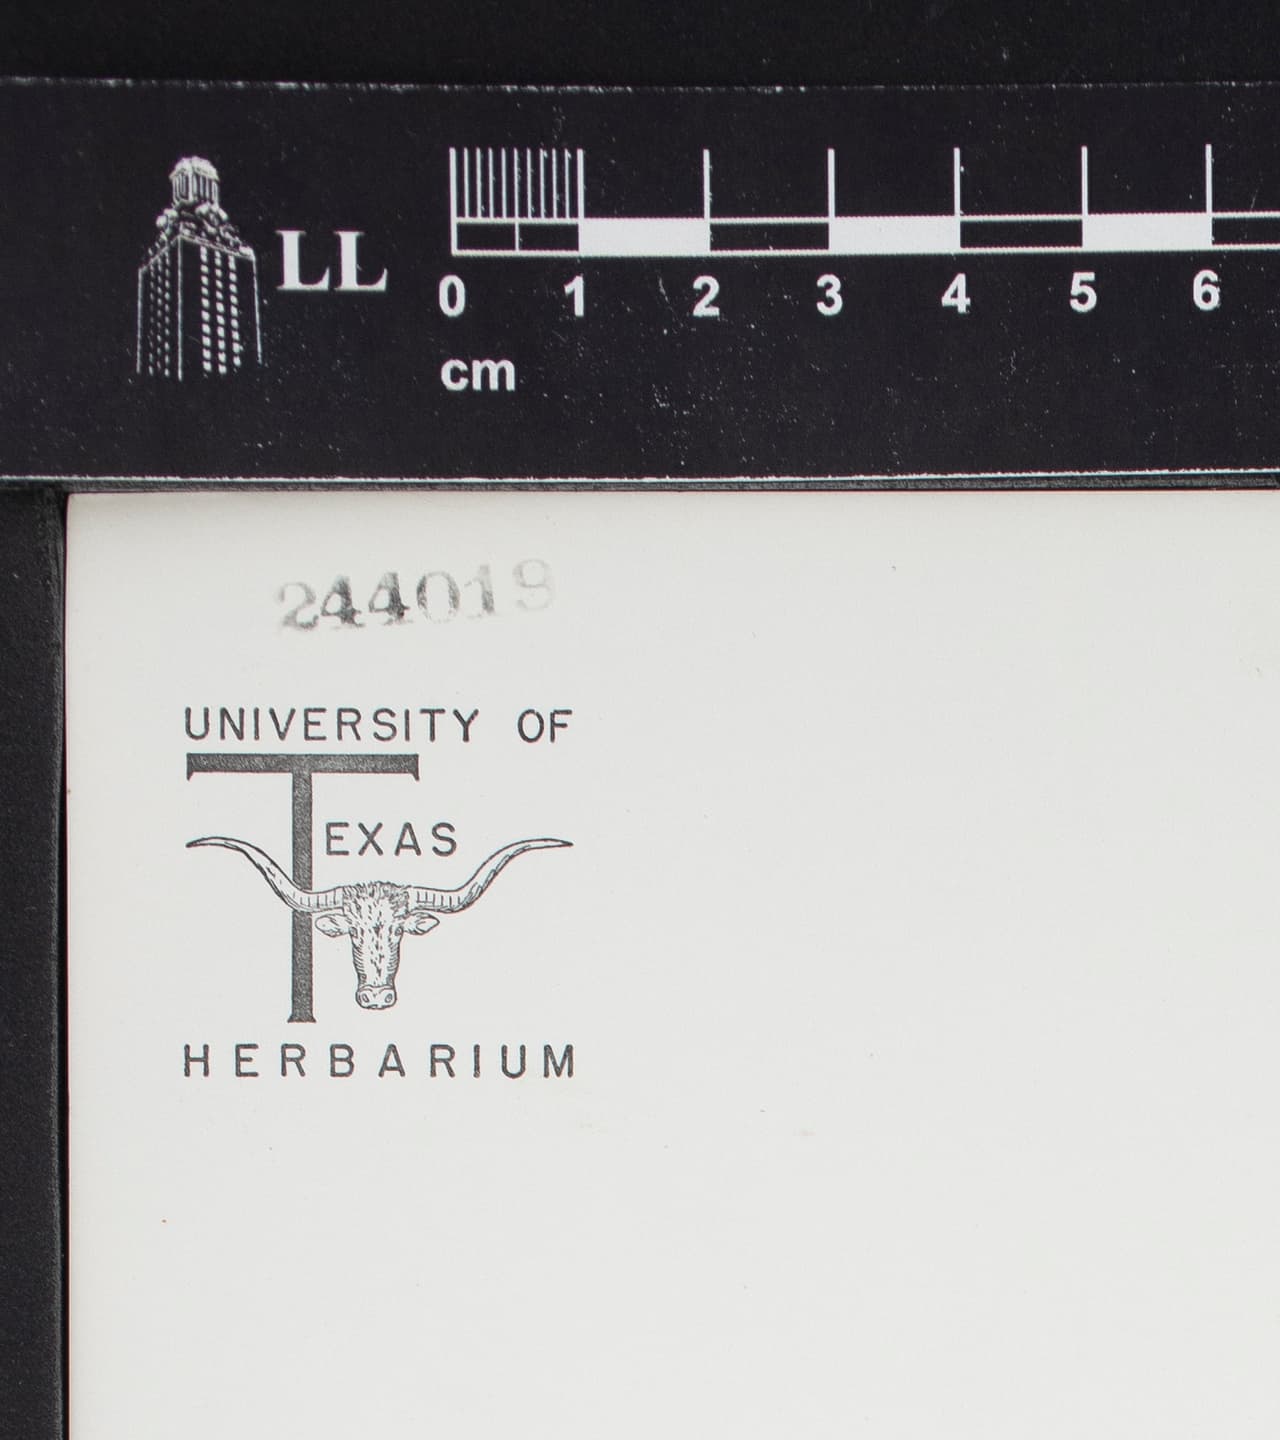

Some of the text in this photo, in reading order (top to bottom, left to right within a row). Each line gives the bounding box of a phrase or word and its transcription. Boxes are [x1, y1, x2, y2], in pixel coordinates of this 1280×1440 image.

[276, 229, 388, 292] LL
[438, 274, 466, 318] 0
[563, 274, 585, 317] 1
[692, 275, 720, 318] 2
[816, 273, 844, 317] 3
[941, 272, 971, 314] 4
[1069, 271, 1098, 313] 5
[1192, 269, 1221, 311] 6
[440, 358, 516, 392] cm
[184, 706, 573, 744] UNIVERSITY OF
[183, 1042, 574, 1080] HERBARIUM
